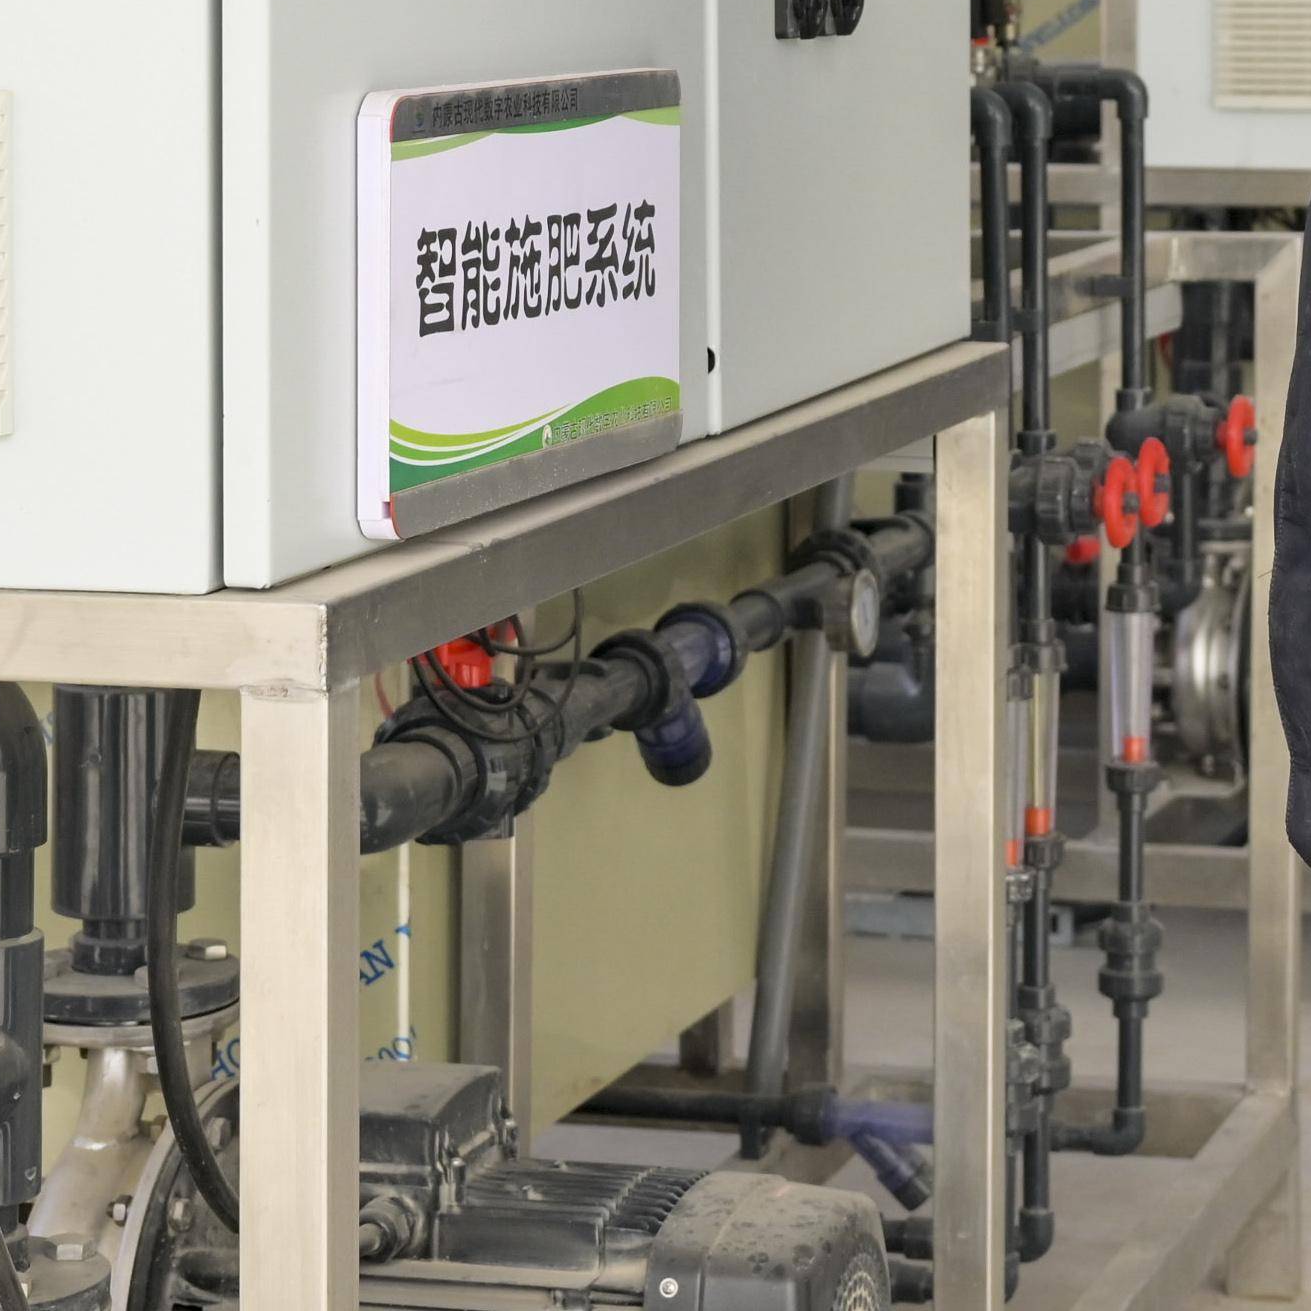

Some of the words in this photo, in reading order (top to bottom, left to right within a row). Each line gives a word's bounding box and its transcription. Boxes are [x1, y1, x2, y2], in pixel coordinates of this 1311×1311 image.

[416, 199, 655, 338] 智能施肥系统
